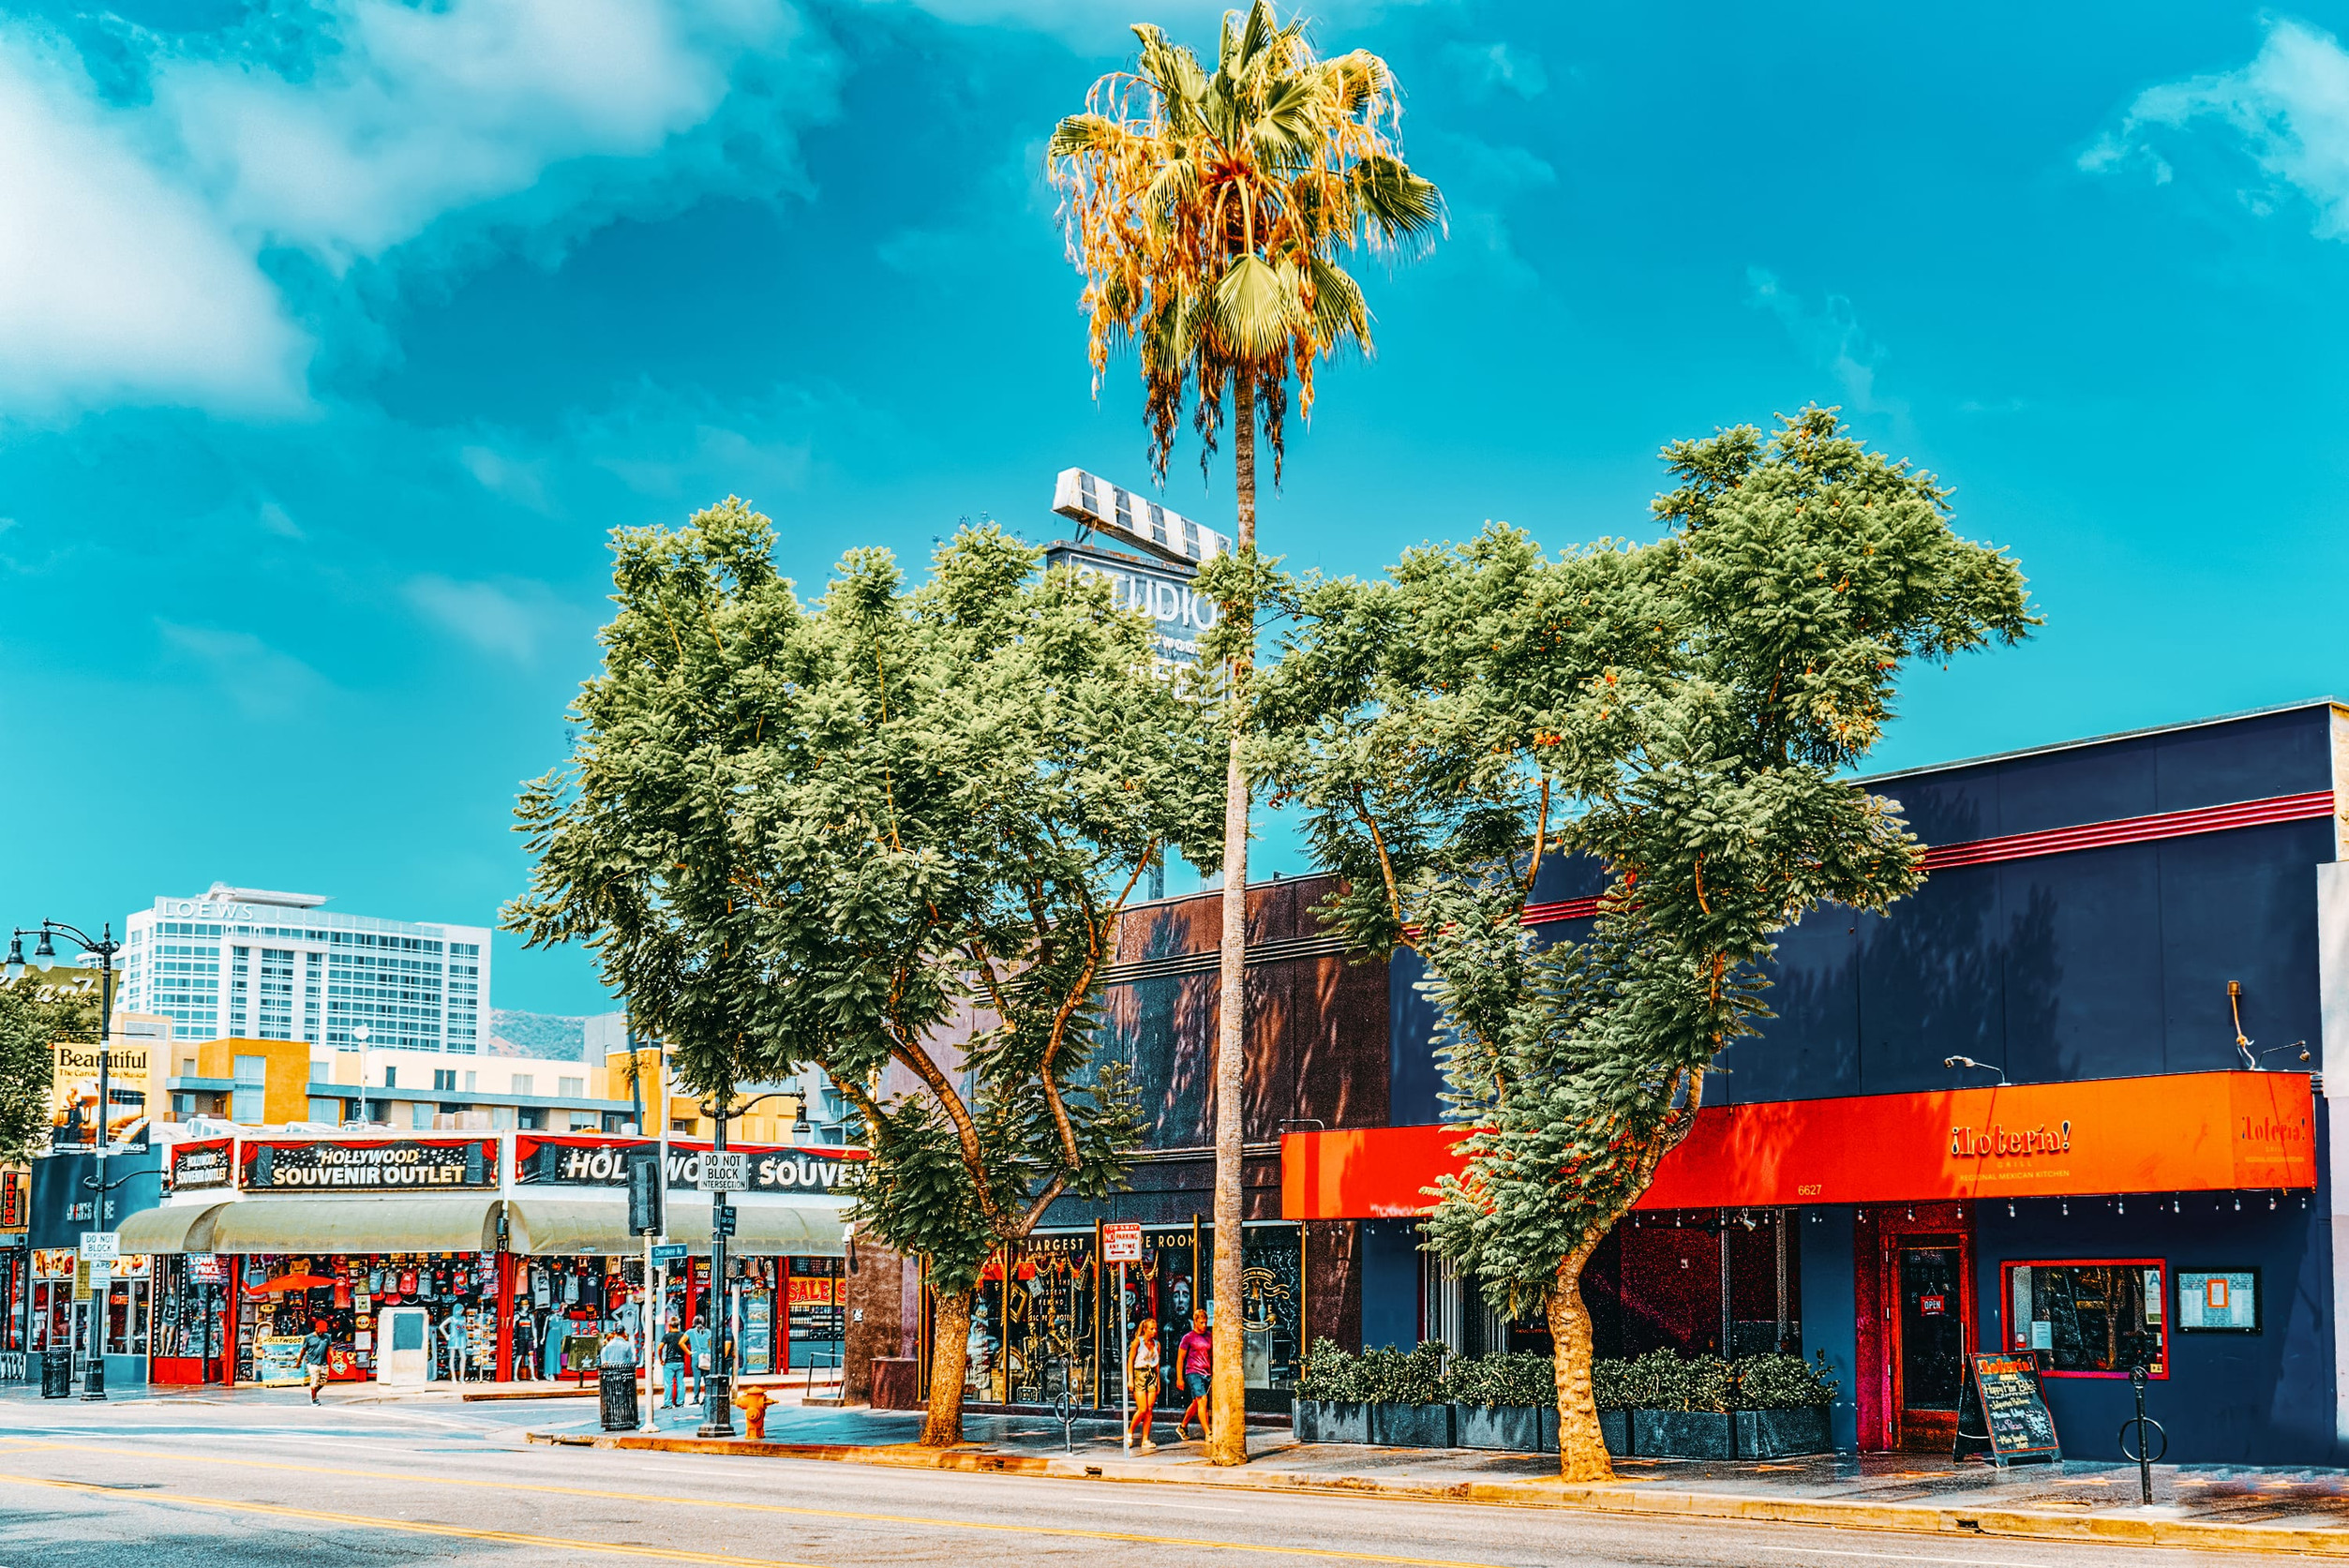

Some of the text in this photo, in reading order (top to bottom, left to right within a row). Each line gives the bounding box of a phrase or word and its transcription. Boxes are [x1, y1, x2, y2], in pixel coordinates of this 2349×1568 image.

[163, 901, 253, 920] LOEWS
[59, 1068, 72, 1077] The
[187, 1154, 217, 1168] HOLLYWOOD
[321, 1149, 419, 1165] HOLLYWOOD
[705, 1156, 741, 1166] DO NOT
[567, 1152, 699, 1183] HOLWO
[708, 1168, 739, 1179] BLOCK
[176, 1167, 227, 1185] SOUVENIR OUTLET
[273, 1165, 466, 1186] SOUVENIR OUTLET
[1960, 1169, 2070, 1182] REGIONAL MEXICAN KITCHEN
[701, 1180, 745, 1188] INTERSECTION
[1798, 1184, 1822, 1196] 6627
[5, 1173, 16, 1224] TATTOO
[86, 1234, 113, 1244] DO NOT
[1105, 1232, 1115, 1242] NO
[88, 1244, 112, 1252] BLOCK
[1028, 1238, 1084, 1251] LARGEST
[654, 1247, 676, 1257] Cherokee
[788, 1279, 830, 1303] SALE
[1923, 1300, 1941, 1310] OPEN
